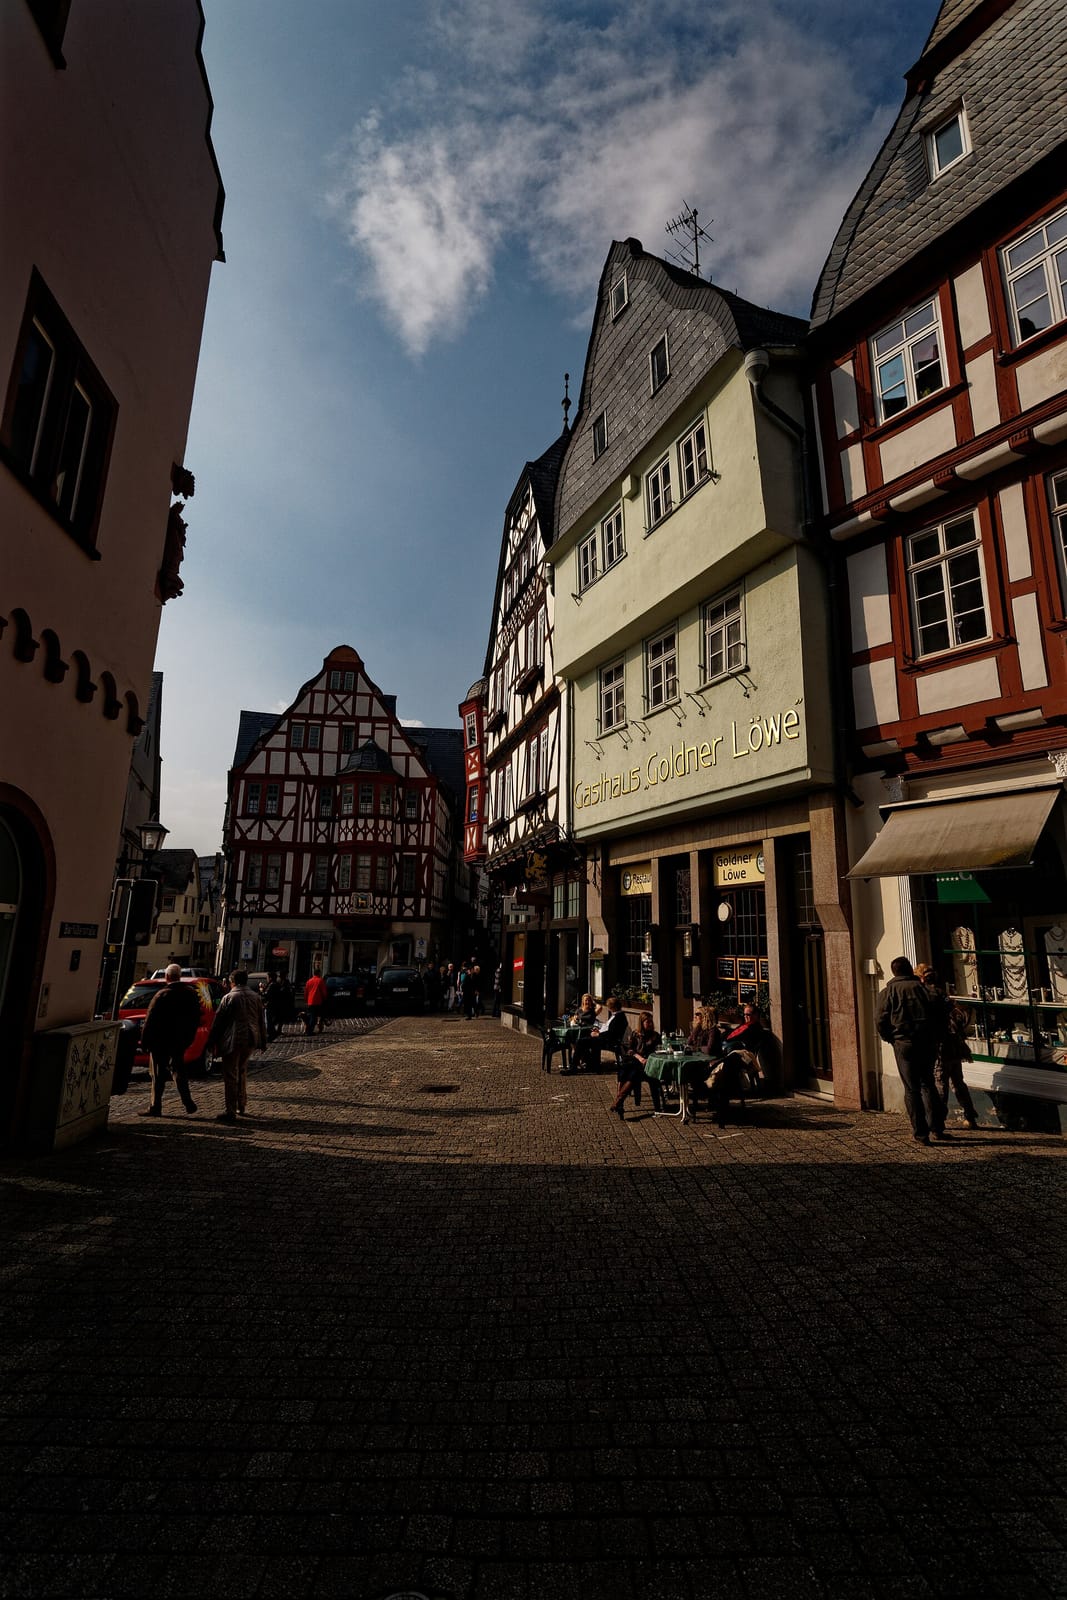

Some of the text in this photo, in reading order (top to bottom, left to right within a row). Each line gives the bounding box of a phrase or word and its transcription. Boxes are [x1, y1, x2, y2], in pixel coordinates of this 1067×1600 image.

[574, 767, 641, 809] Gasthaus
[716, 853, 752, 867] Goldner
[723, 868, 747, 881] Löwe
